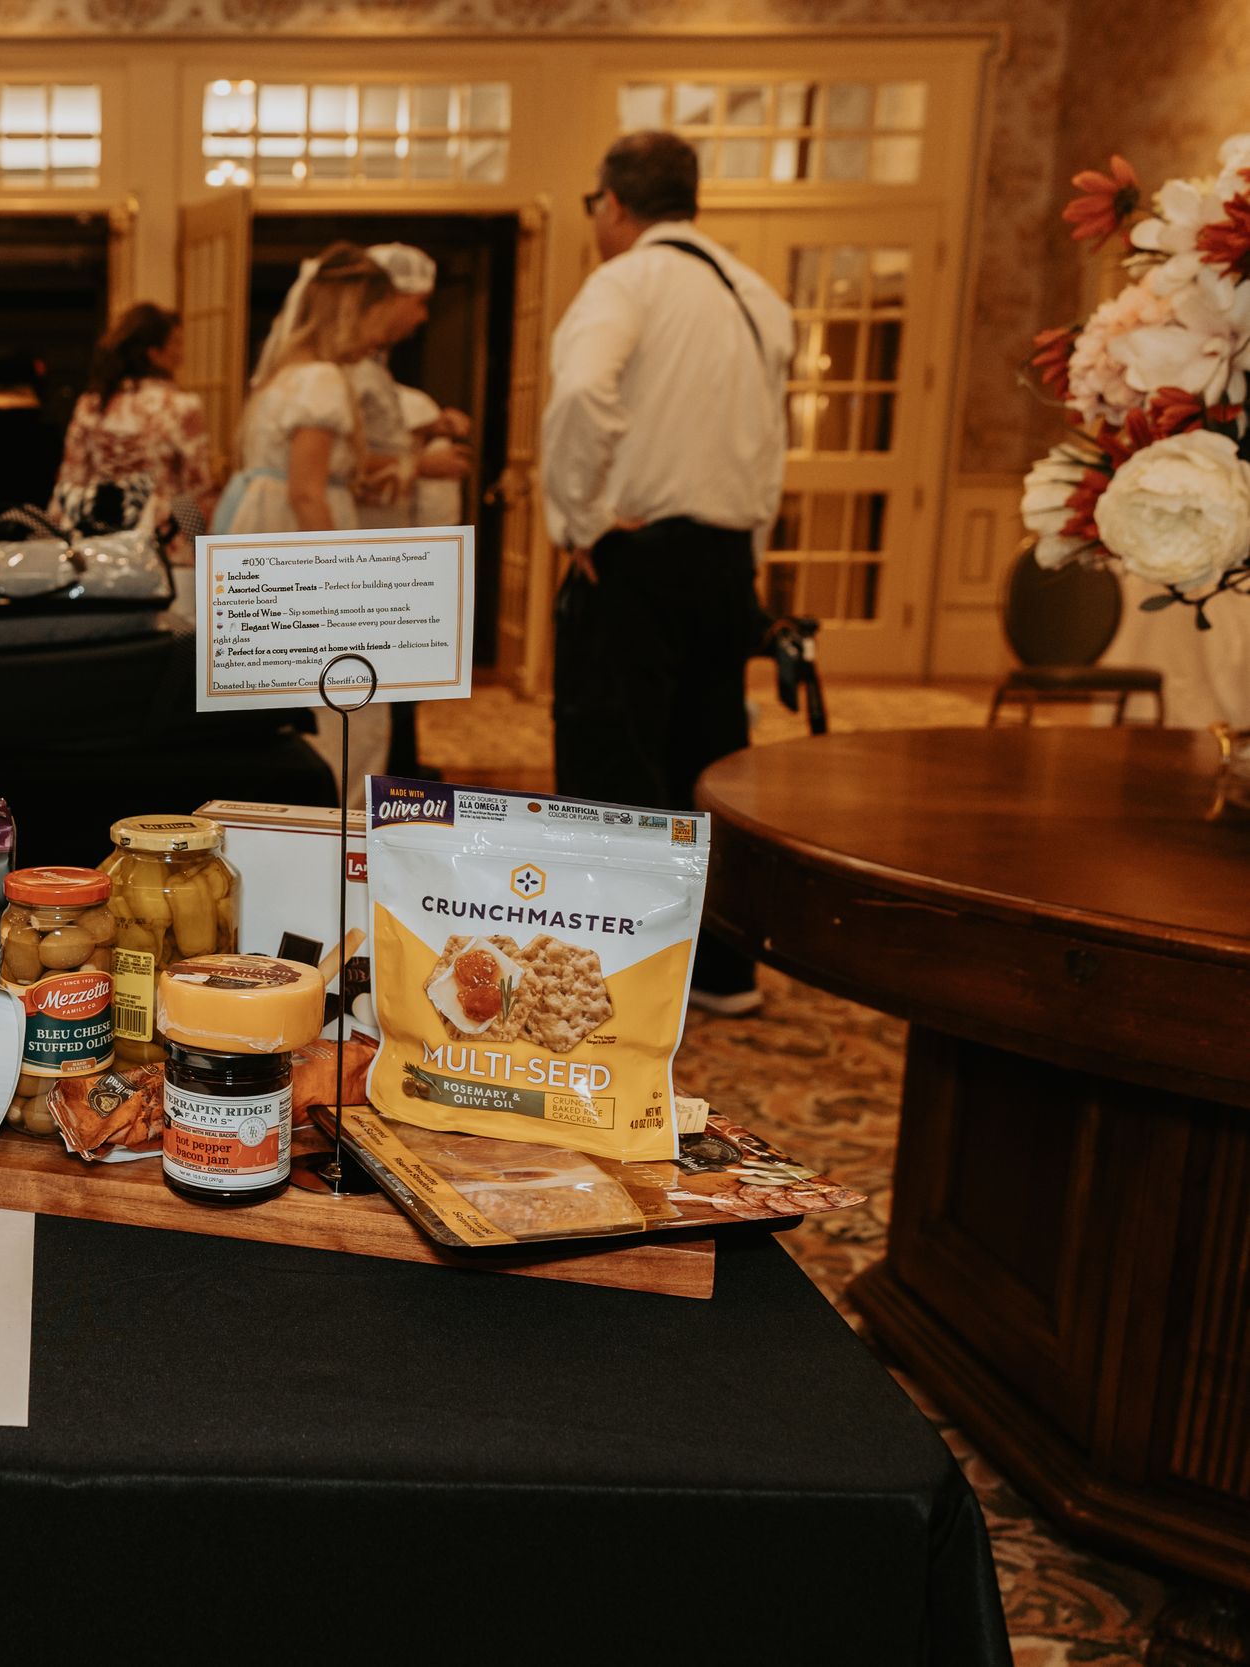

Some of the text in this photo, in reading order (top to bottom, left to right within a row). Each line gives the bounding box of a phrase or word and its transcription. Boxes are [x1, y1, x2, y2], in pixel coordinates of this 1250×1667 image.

[242, 557, 265, 567] #030
[314, 555, 337, 565] Board
[338, 554, 355, 564] with
[356, 554, 368, 563] An
[227, 579, 435, 594] Assorted Gourmet Treats Perfect for building your dream
[212, 596, 278, 606] charcuterie board
[227, 603, 411, 619] Bottle of Wine Sip something smooth you snack
[241, 615, 440, 632] Elegant Wine Glasses Because every pour deserves the
[213, 635, 251, 645] right glass
[227, 647, 254, 657] Perfect
[255, 646, 265, 656] for
[289, 645, 318, 655] evening
[319, 645, 327, 653] at
[328, 644, 349, 653] home
[349, 642, 366, 652] with
[367, 641, 391, 650] friends
[398, 640, 430, 649] delicious
[213, 656, 323, 669] laughter, and memory-making
[213, 675, 356, 690] Donated the Sumter Sheriff's
[390, 788, 407, 797] MADE
[408, 789, 425, 799] WITH
[378, 800, 419, 821] Olive
[422, 799, 448, 818] Oil
[459, 800, 599, 816] ALA OMEGA NO ARTIFICIAL
[548, 811, 569, 819] COLORS
[577, 814, 600, 822] FLAVORS
[38, 980, 110, 1010] Mezzetta
[62, 1006, 86, 1015] FAMILY
[37, 1020, 111, 1040] BLEU CHEESE
[28, 1041, 84, 1053] STUFFED
[422, 1040, 611, 1092] MULTI-SEED
[443, 1080, 521, 1102] ROSEMARY &
[165, 1091, 272, 1117] TERRAPIN RIDGE
[453, 1094, 514, 1109] OLIVE OIL
[552, 1104, 603, 1118] BAKED RICE
[552, 1111, 598, 1125] CRACKERS
[645, 1106, 662, 1118] NET WT
[630, 1119, 639, 1130] 4.0
[639, 1118, 646, 1128] OZ
[204, 1130, 218, 1138] REAL
[175, 1131, 232, 1155] hot pepper
[176, 1145, 230, 1165] bacon jam
